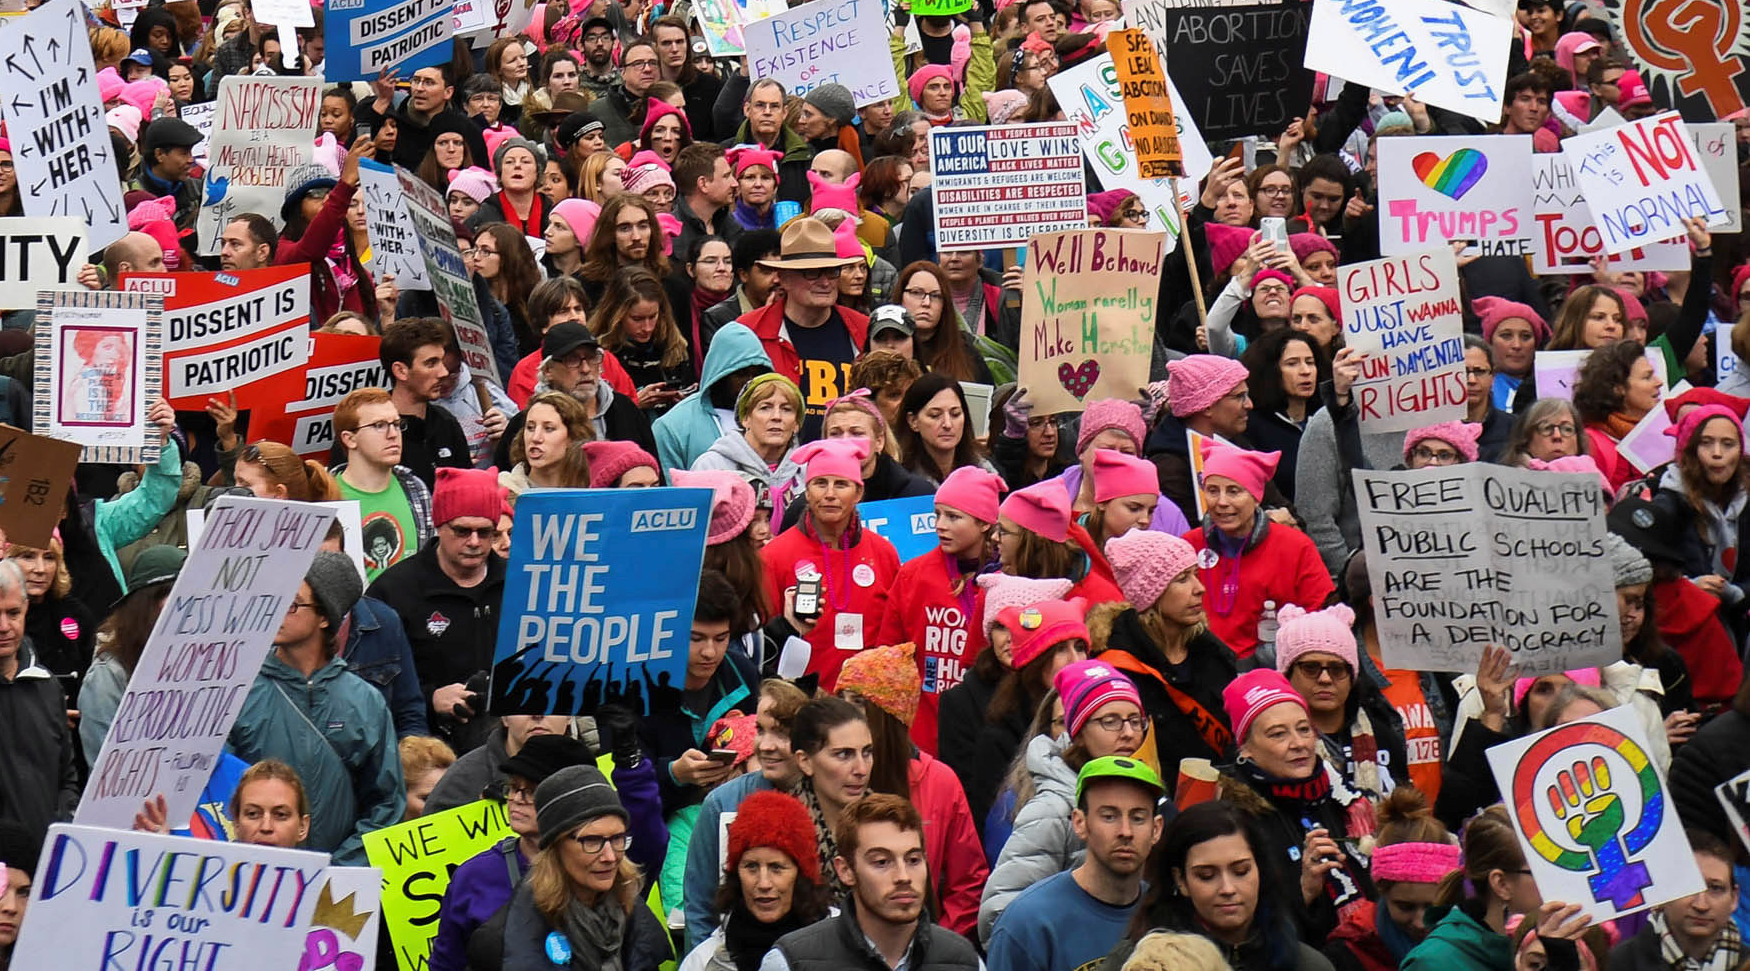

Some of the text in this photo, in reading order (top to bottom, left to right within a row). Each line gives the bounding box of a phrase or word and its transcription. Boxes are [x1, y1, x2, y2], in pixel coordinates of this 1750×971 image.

[774, 2, 859, 45] RESPECT
[370, 21, 445, 66] PATRIOTIC
[756, 31, 860, 79] EXISTENCE
[1419, 13, 1498, 102] TRUST
[1215, 56, 1288, 89] SAVES
[225, 85, 317, 130] NARCISSISM
[1205, 91, 1288, 131] LIVES
[33, 120, 90, 153] WITH
[936, 135, 985, 155] IN OUR
[1036, 128, 1049, 136] ARE
[1053, 127, 1075, 135] EQUAL
[938, 156, 987, 171] AMERICA
[991, 138, 1079, 158] LOVE WINS
[49, 148, 91, 181] HER
[936, 177, 981, 187] IMMIGRANTS
[992, 174, 1027, 184] REFUGEES
[1031, 173, 1043, 181] ARE
[1047, 172, 1081, 180] WELCOME
[992, 158, 1077, 171] BLACK LIVES MATTER
[940, 186, 1081, 202] DISABILITIES ARE RESPECTED
[995, 203, 1021, 211] CHARGE
[374, 225, 407, 239] WITH
[975, 217, 998, 225] PLANET
[1002, 215, 1012, 223] ARE
[1016, 214, 1039, 222] VALUED
[1060, 211, 1082, 219] PROFIT
[1603, 190, 1723, 252] NORMAL
[380, 239, 403, 254] HER
[940, 228, 1011, 242] DIVERSITY IS
[1481, 239, 1534, 257] HATE
[128, 279, 176, 295] ACLU
[1348, 260, 1439, 301] GIRLS
[170, 289, 295, 342] DISSENT IS
[1352, 301, 1459, 333] JUST WANNA
[1383, 328, 1435, 350] HAVE
[185, 339, 293, 389] PATRIOTIC
[1361, 374, 1466, 418] RIGHTS
[1368, 478, 1599, 519] FREE QUALITY
[632, 509, 696, 530] ACLU
[532, 515, 601, 562] WE
[1378, 527, 1604, 559] PUBLIC SCHOOLS
[212, 556, 259, 589] NOT
[1383, 569, 1511, 592] ARE THE
[525, 565, 609, 613] THE
[1383, 594, 1607, 620] FOUNDATION FOR
[518, 612, 674, 662] PEOPLE
[1411, 625, 1607, 652] A DEMOCRACY
[109, 684, 245, 742] REPRODUCTIVE
[41, 834, 319, 927] DIVERSITY
